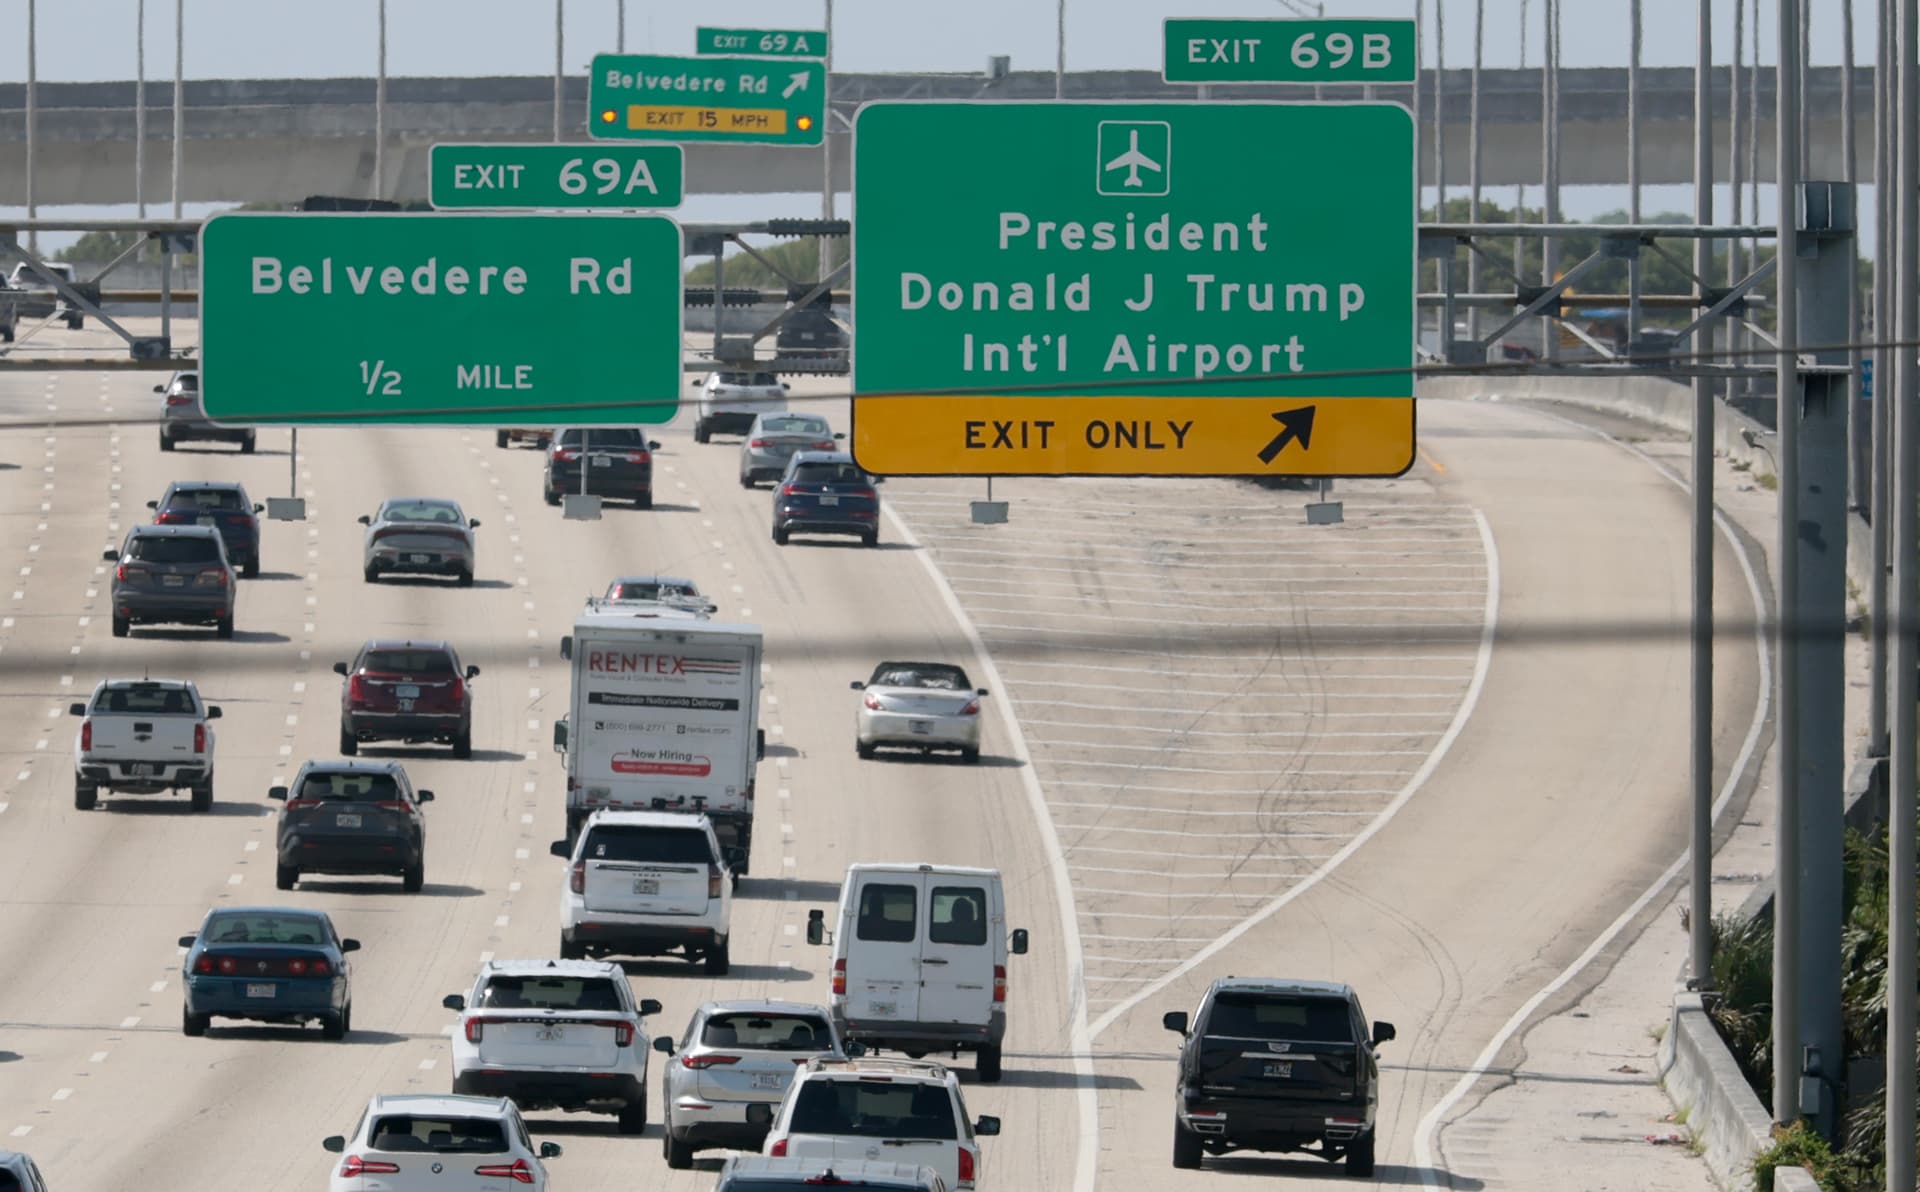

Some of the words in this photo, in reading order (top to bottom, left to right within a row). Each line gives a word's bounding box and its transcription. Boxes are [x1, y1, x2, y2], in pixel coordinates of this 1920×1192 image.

[713, 35, 747, 48] EXIT
[1188, 38, 1261, 63] EXIT
[1290, 32, 1392, 69] 69B
[606, 70, 726, 93] Belvedere
[739, 74, 768, 94] Rd
[645, 111, 685, 125] EXIT
[698, 111, 718, 127] 15
[731, 114, 769, 127] MPH
[454, 164, 525, 189] EXIT
[559, 158, 658, 195] 69A
[999, 212, 1268, 252] President
[252, 256, 528, 295] Belvedere
[570, 257, 632, 295] Rd
[901, 272, 1090, 312] Donald
[1124, 273, 1154, 312] J
[1186, 274, 1365, 321] Trump
[963, 333, 1067, 372] Int'l
[1103, 334, 1305, 378] Airport
[457, 364, 533, 389] MILE
[965, 420, 1055, 449] EXIT
[1085, 419, 1193, 450] ONLY
[589, 651, 686, 675] RENTEX
[601, 694, 644, 704] Immediate
[646, 695, 690, 707] Nationwide
[692, 698, 726, 709] Delivery
[631, 748, 656, 759] Now
[659, 750, 693, 762] Hiring
